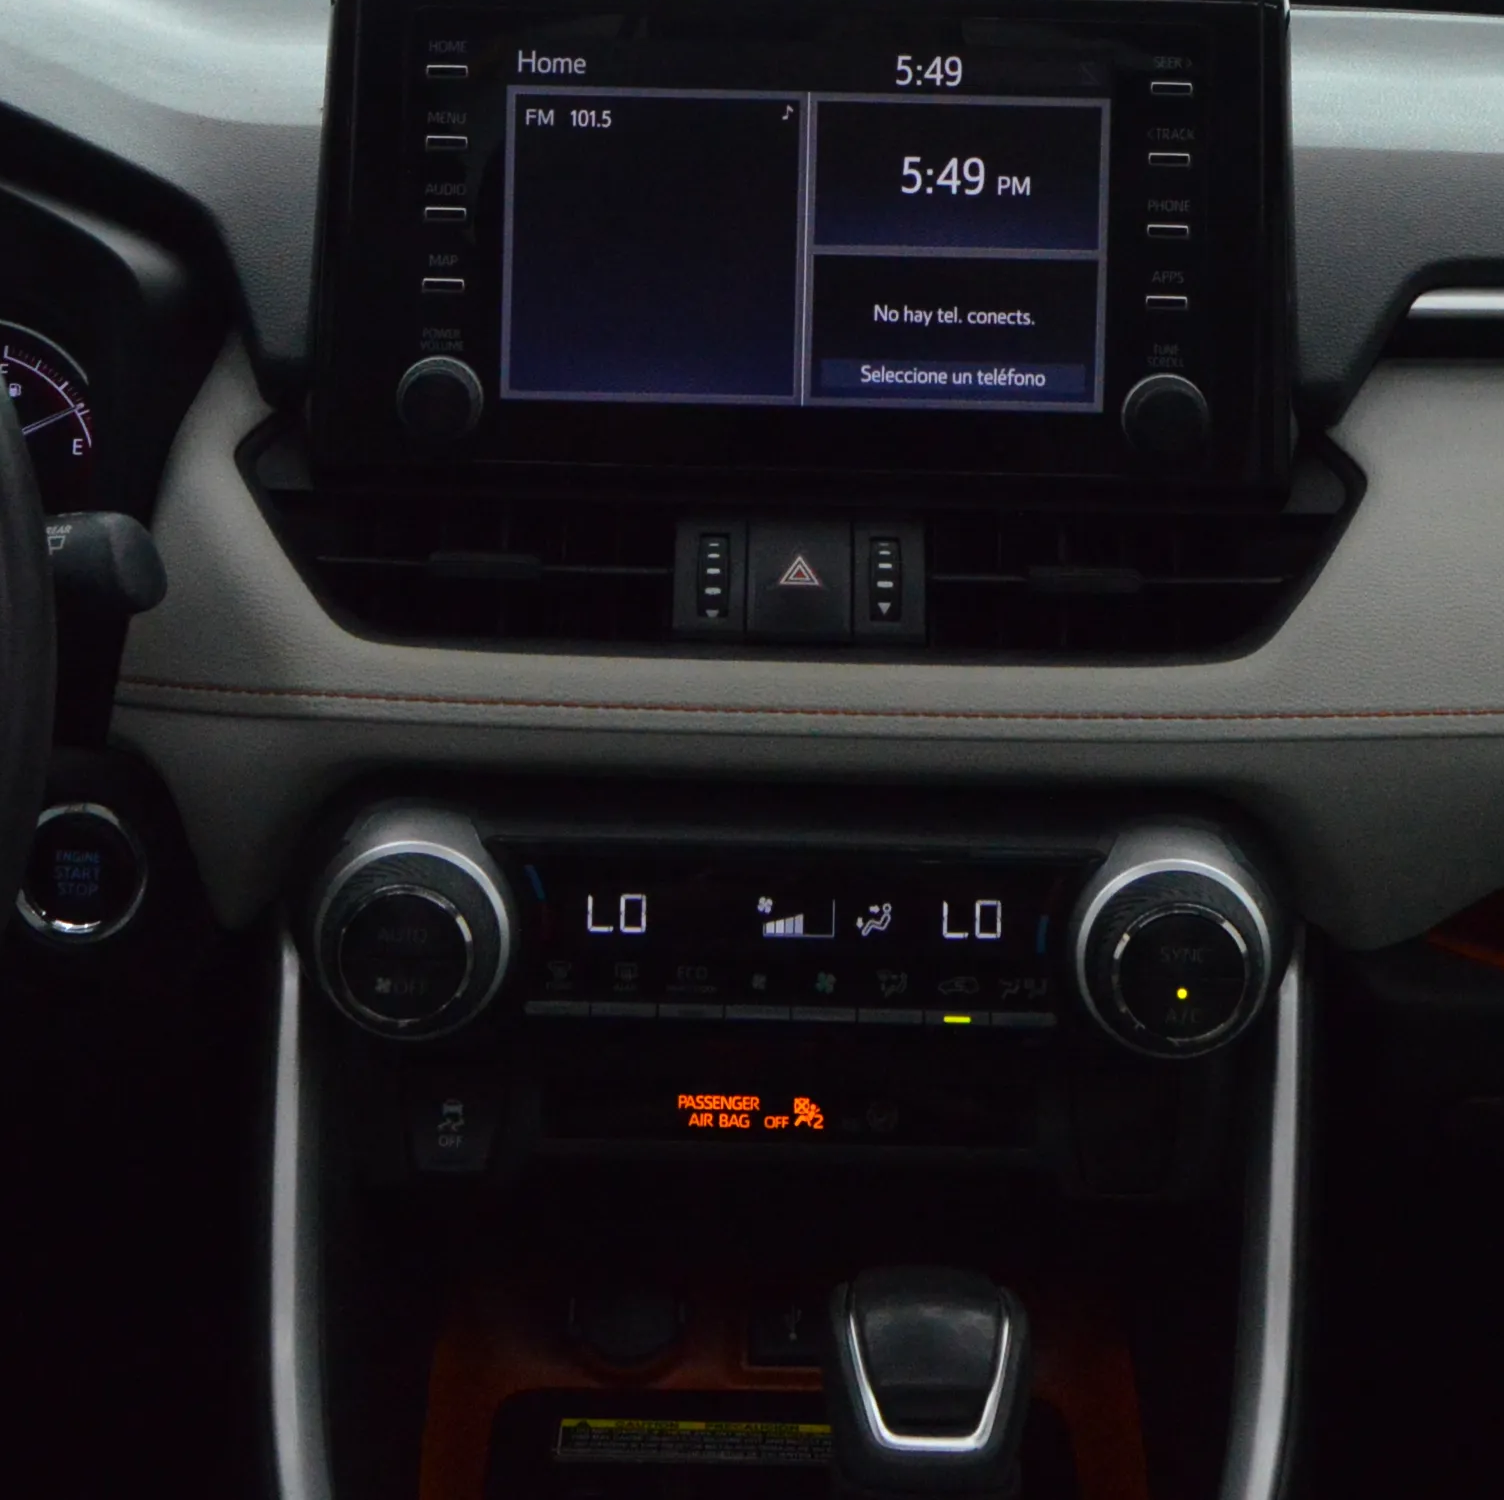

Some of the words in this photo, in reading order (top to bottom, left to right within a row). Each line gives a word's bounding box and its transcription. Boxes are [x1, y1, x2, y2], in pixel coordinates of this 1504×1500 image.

[428, 40, 468, 54] HOME
[516, 50, 587, 75] Home
[895, 54, 963, 87] 5:49
[427, 111, 467, 125] MENU
[525, 108, 555, 127] FM
[570, 109, 613, 129] 101.5
[900, 156, 987, 198] 5:49
[996, 174, 1032, 197] PM
[424, 182, 467, 196] AUDIO
[1147, 199, 1192, 213] PHONE
[428, 254, 459, 268] MAP
[1151, 270, 1185, 284] APPS
[873, 304, 899, 322] No
[903, 305, 933, 327] hay
[936, 306, 964, 324] tel.
[967, 309, 1036, 326] conects.
[421, 327, 462, 340] POWER
[860, 364, 949, 385] Seleccione
[952, 371, 973, 385] un
[976, 367, 1047, 388] teléfono
[72, 438, 84, 456] E
[55, 850, 101, 864] ENGINE
[53, 865, 101, 881] START
[56, 882, 100, 897] STOP
[586, 893, 648, 934] LO
[942, 898, 1003, 939] LO
[377, 926, 429, 944] AUTO
[1159, 946, 1208, 964] SYNC
[392, 978, 427, 996] OFF
[1164, 1007, 1202, 1025] A/C
[677, 1094, 760, 1112] PASSENGER
[688, 1112, 714, 1128] AIR
[718, 1113, 750, 1129] BAG
[763, 1115, 790, 1130] OFF
[438, 1134, 464, 1150] OFF
